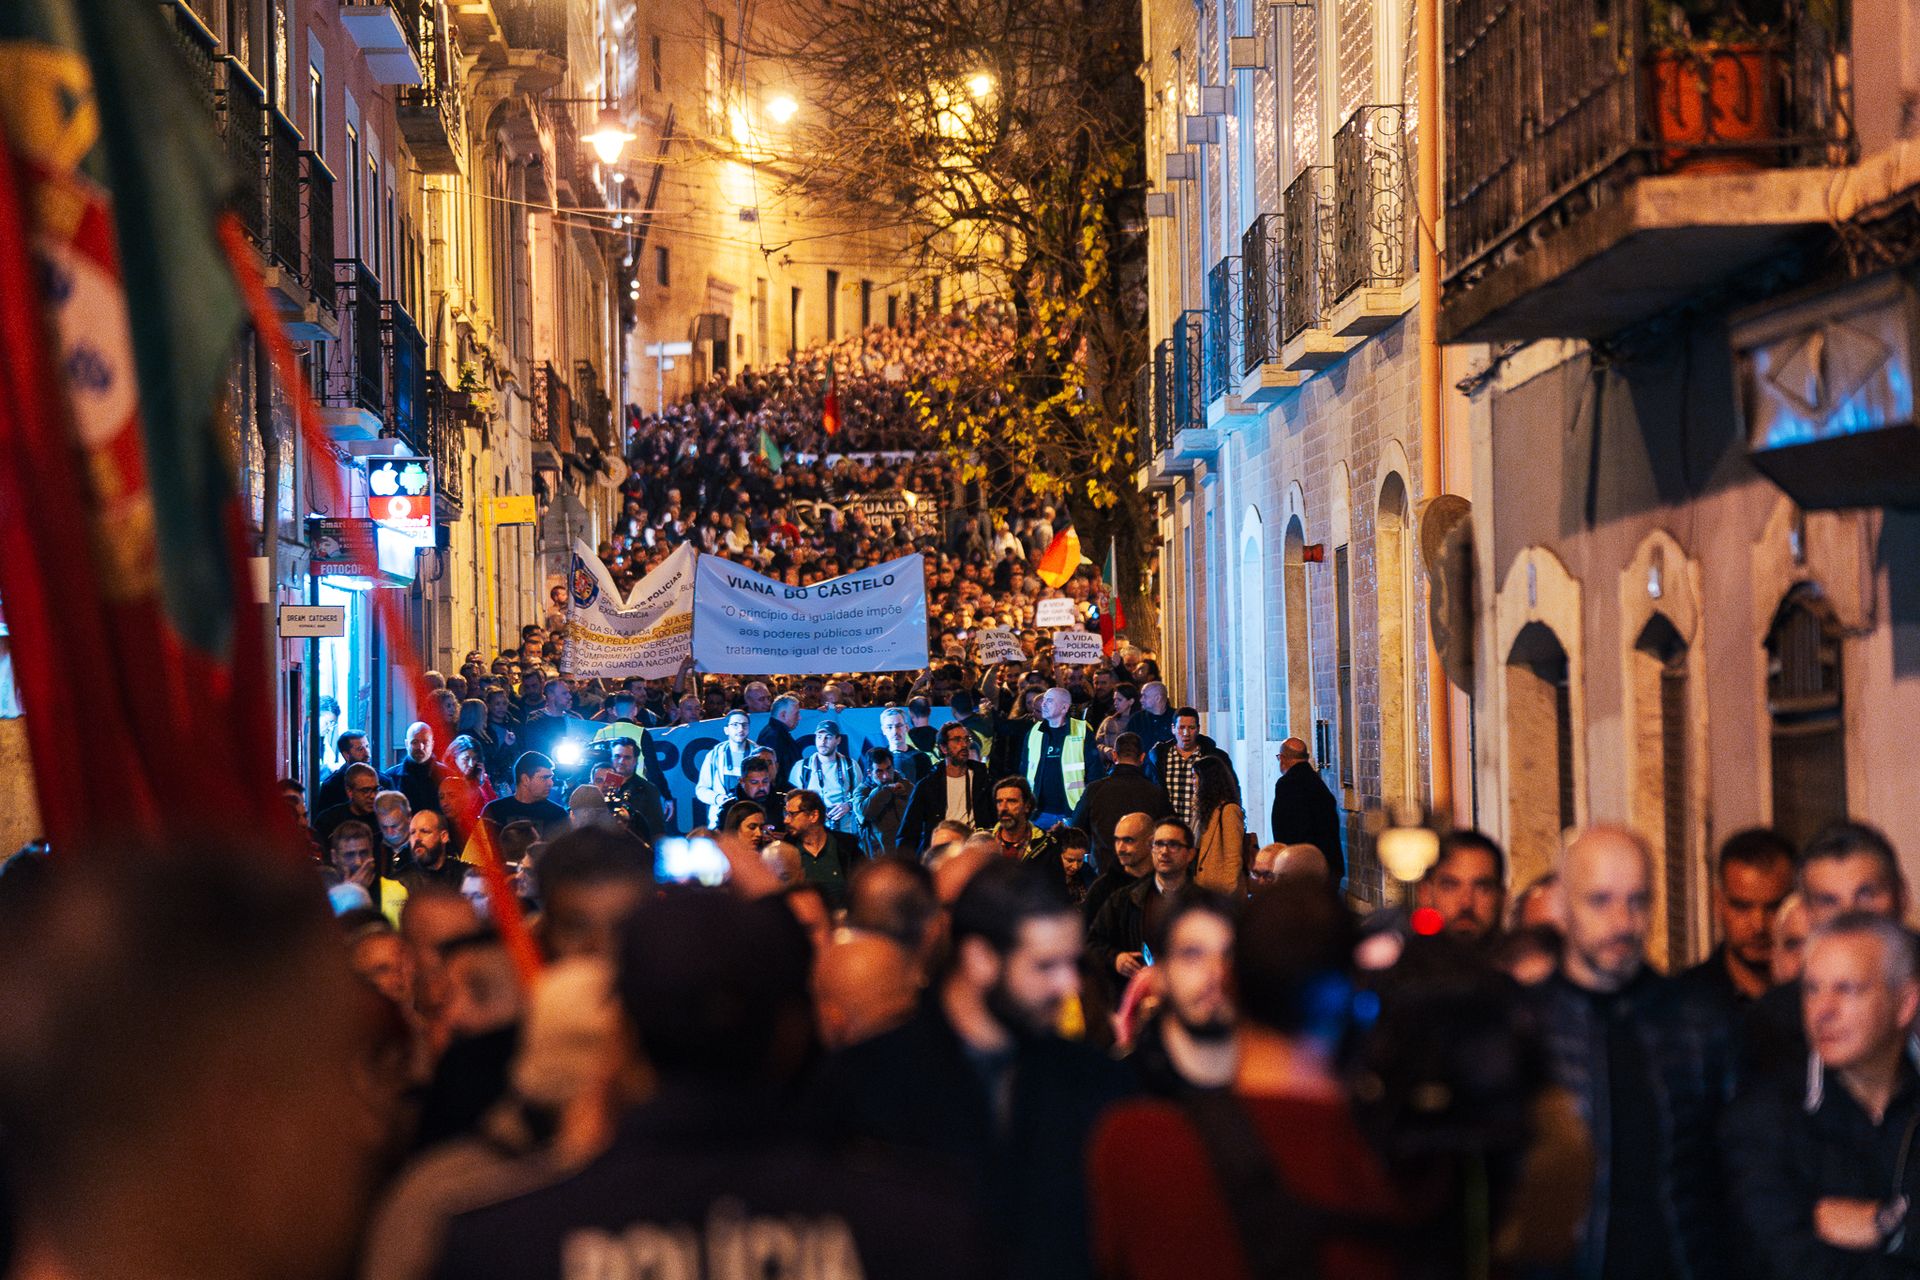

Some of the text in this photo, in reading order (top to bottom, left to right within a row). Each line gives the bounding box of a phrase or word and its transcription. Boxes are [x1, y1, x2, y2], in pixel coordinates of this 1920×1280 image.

[727, 574, 895, 600] VIANA DO CASTELO
[287, 614, 338, 622] DREAM CATCHERS
[739, 607, 788, 622] princípio
[791, 610, 806, 621] da
[809, 607, 863, 624] igualdade
[866, 604, 902, 618] impõe
[590, 623, 602, 633] DA
[739, 625, 884, 640] aos poderes públicos um
[985, 632, 993, 640] A
[1072, 634, 1094, 642] VIDA
[980, 641, 996, 650] PSP
[643, 650, 657, 659] DO
[726, 644, 789, 656] tratamento
[792, 644, 820, 658] igual
[822, 643, 838, 655] de
[1058, 651, 1099, 659] IMPORTA
[604, 659, 644, 669] GUARDA
